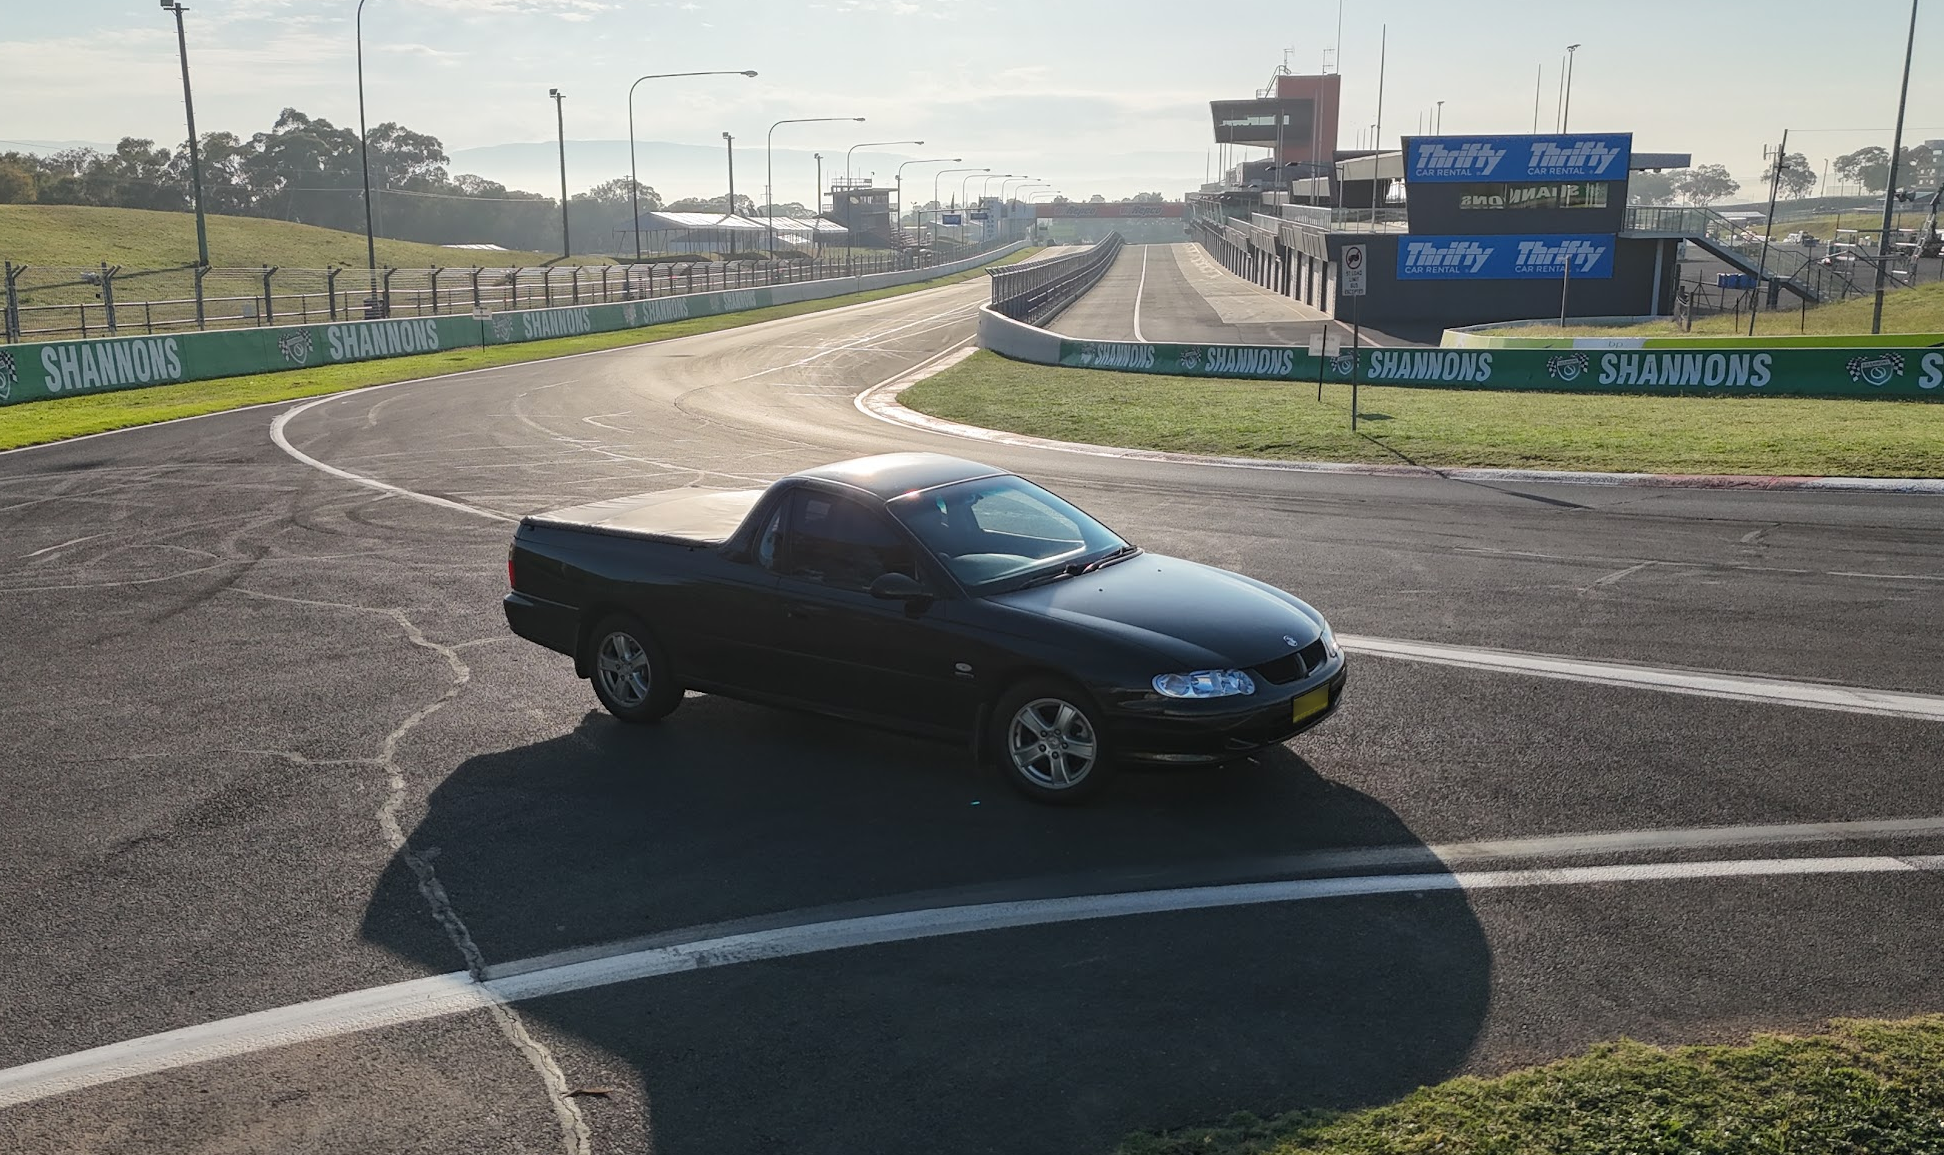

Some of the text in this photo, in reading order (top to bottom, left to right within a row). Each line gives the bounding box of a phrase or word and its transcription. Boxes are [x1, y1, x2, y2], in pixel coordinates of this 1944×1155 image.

[1416, 143, 1507, 176] Thrifty
[1436, 168, 1472, 176] RENTAL
[1527, 167, 1585, 175] CAR RENTAL
[1528, 141, 1620, 174] Thrifty
[1066, 205, 1096, 216] Repco
[1132, 205, 1161, 215] Repco
[1404, 265, 1461, 274] CAR RENTAL
[1405, 241, 1495, 273] Thrifty
[1514, 265, 1572, 273] CAR RENTA
[1515, 240, 1606, 272] Thrifty
[643, 298, 689, 324] SHANNONS
[723, 290, 757, 311] SHANNONS
[523, 306, 591, 338] SHANNONS
[328, 319, 440, 361] SHANNONS
[1608, 340, 1623, 349] bp
[41, 337, 182, 393] SHANNONS
[1094, 344, 1155, 369] SHANNONS
[1204, 346, 1294, 376] SHANNONS
[1367, 351, 1493, 382] SHANNONS
[1598, 353, 1773, 388] SHANNONS
[1919, 352, 1944, 389] S
